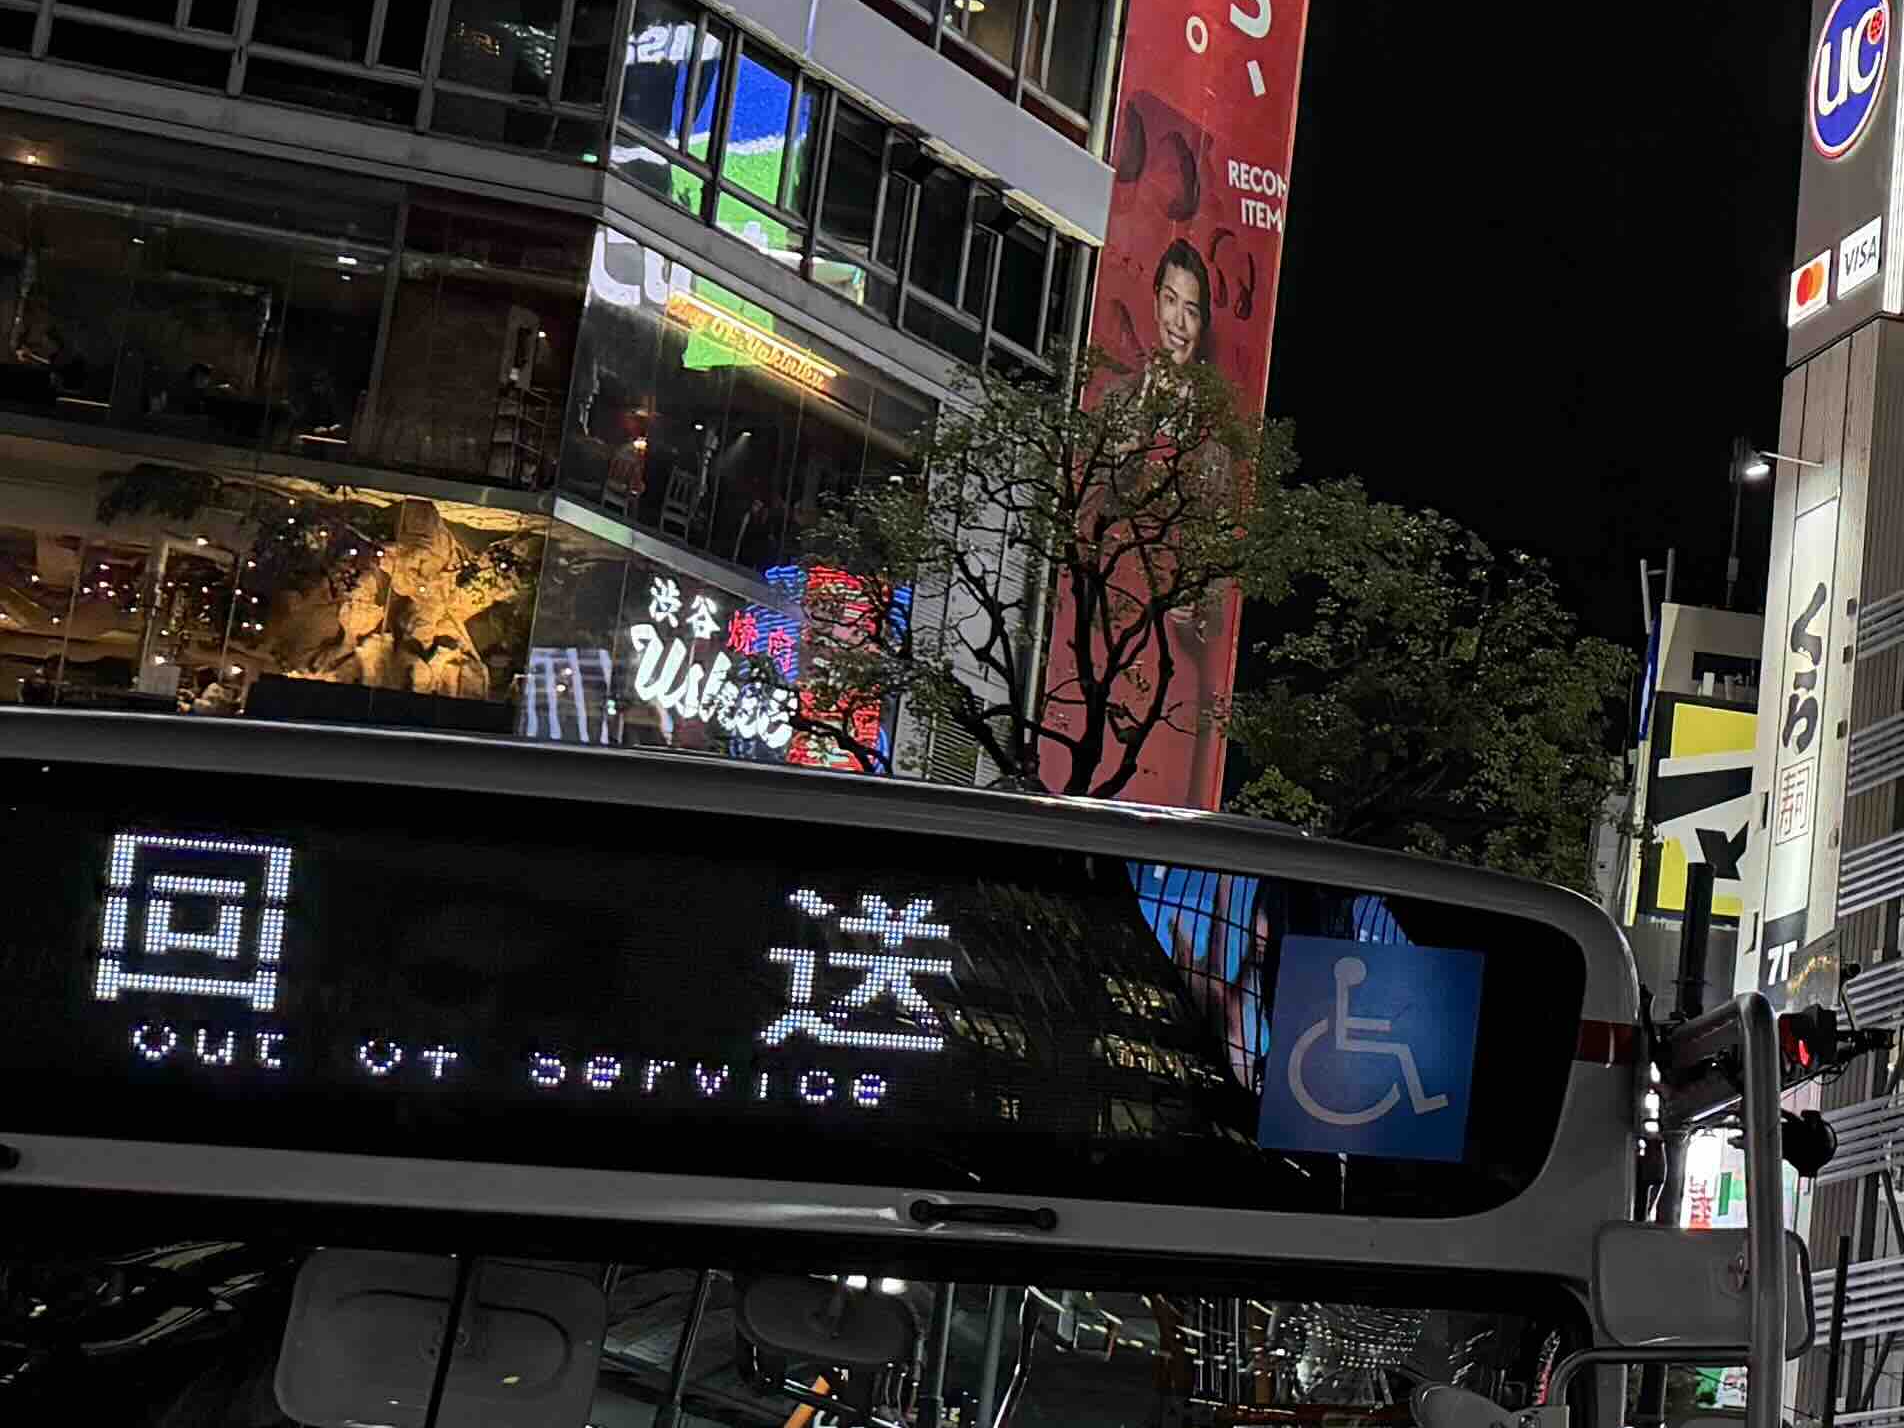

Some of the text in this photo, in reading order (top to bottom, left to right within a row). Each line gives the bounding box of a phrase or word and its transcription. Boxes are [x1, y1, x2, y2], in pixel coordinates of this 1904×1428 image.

[1843, 236, 1879, 278] VISA
[649, 575, 721, 640] 渋谷
[95, 832, 953, 1051] 回 送
